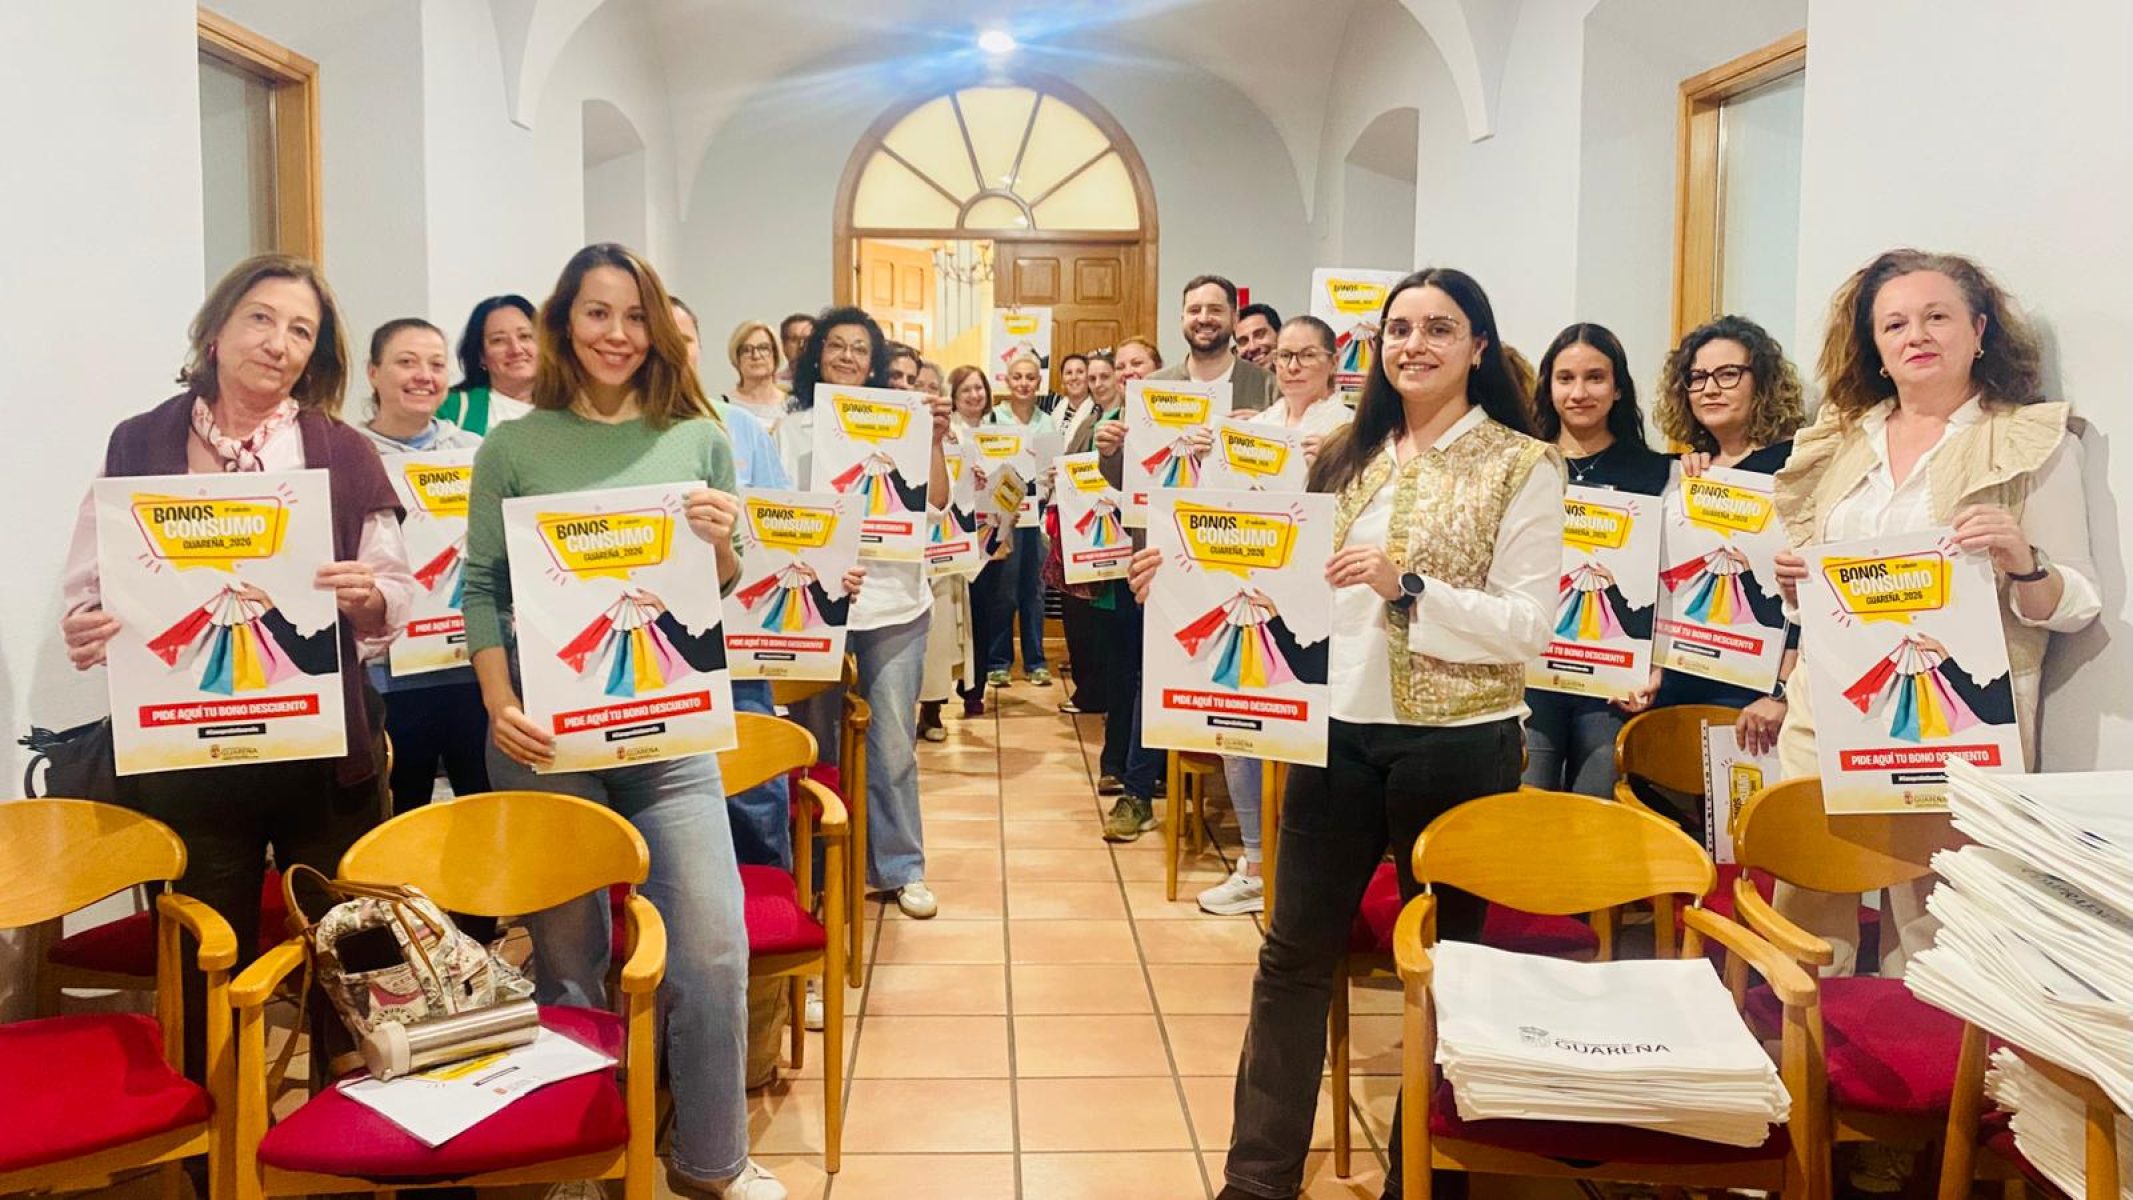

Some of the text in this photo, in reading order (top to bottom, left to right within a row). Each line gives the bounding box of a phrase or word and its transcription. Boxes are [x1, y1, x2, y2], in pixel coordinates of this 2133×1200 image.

[419, 471, 461, 486] BONOS
[1690, 484, 1730, 499] BONOS
[153, 505, 214, 523] BONOS
[756, 507, 795, 520] BONOS
[1693, 494, 1761, 517] CONSUMO
[163, 515, 267, 539] CONSUMO
[556, 519, 609, 540] BONOS
[761, 517, 823, 533] CONSUMO
[1189, 514, 1237, 530] BONOS
[566, 525, 656, 553] CONSUMO
[1197, 527, 1278, 548] CONSUMO
[1839, 563, 1889, 584] BONOS
[1849, 570, 1933, 597] CONSUMO
[1851, 754, 1873, 766] PIDE
[1873, 751, 1894, 767] AQUÍ
[1895, 753, 1908, 763] TU
[1908, 752, 1934, 764] BONO
